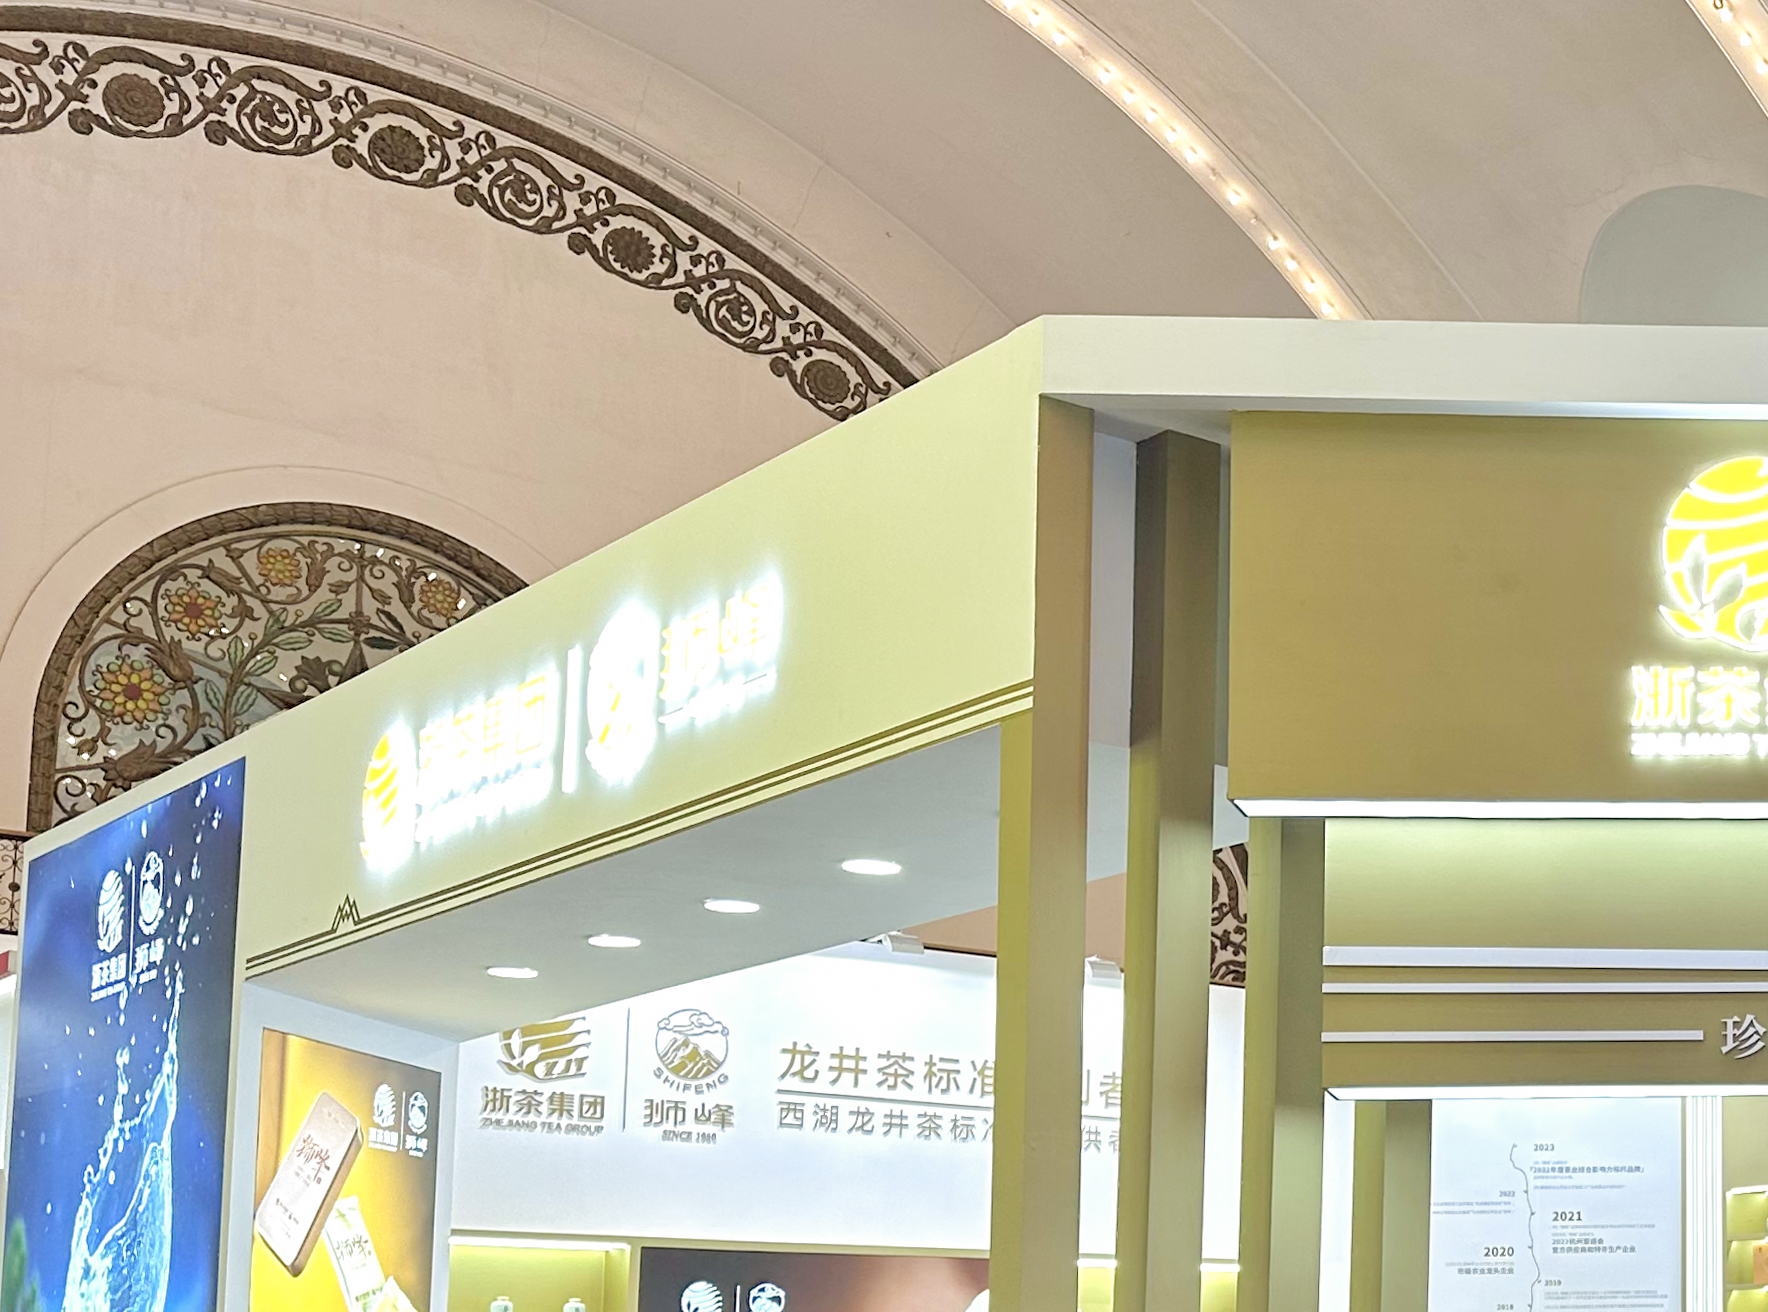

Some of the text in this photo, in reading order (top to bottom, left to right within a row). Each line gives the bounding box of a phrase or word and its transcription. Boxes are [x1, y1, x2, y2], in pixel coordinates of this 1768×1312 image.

[653, 1066, 730, 1095] SHIFENG
[778, 1040, 995, 1099] 龙井茶标准
[479, 1085, 606, 1123] 浙茶集团
[643, 1098, 735, 1133] 狮峰
[479, 1116, 605, 1137] ZHEJIANG TEA GROUP
[661, 1129, 693, 1144] SINCE
[1552, 1211, 1583, 1222] 2021
[1483, 1246, 1515, 1258] 2020
